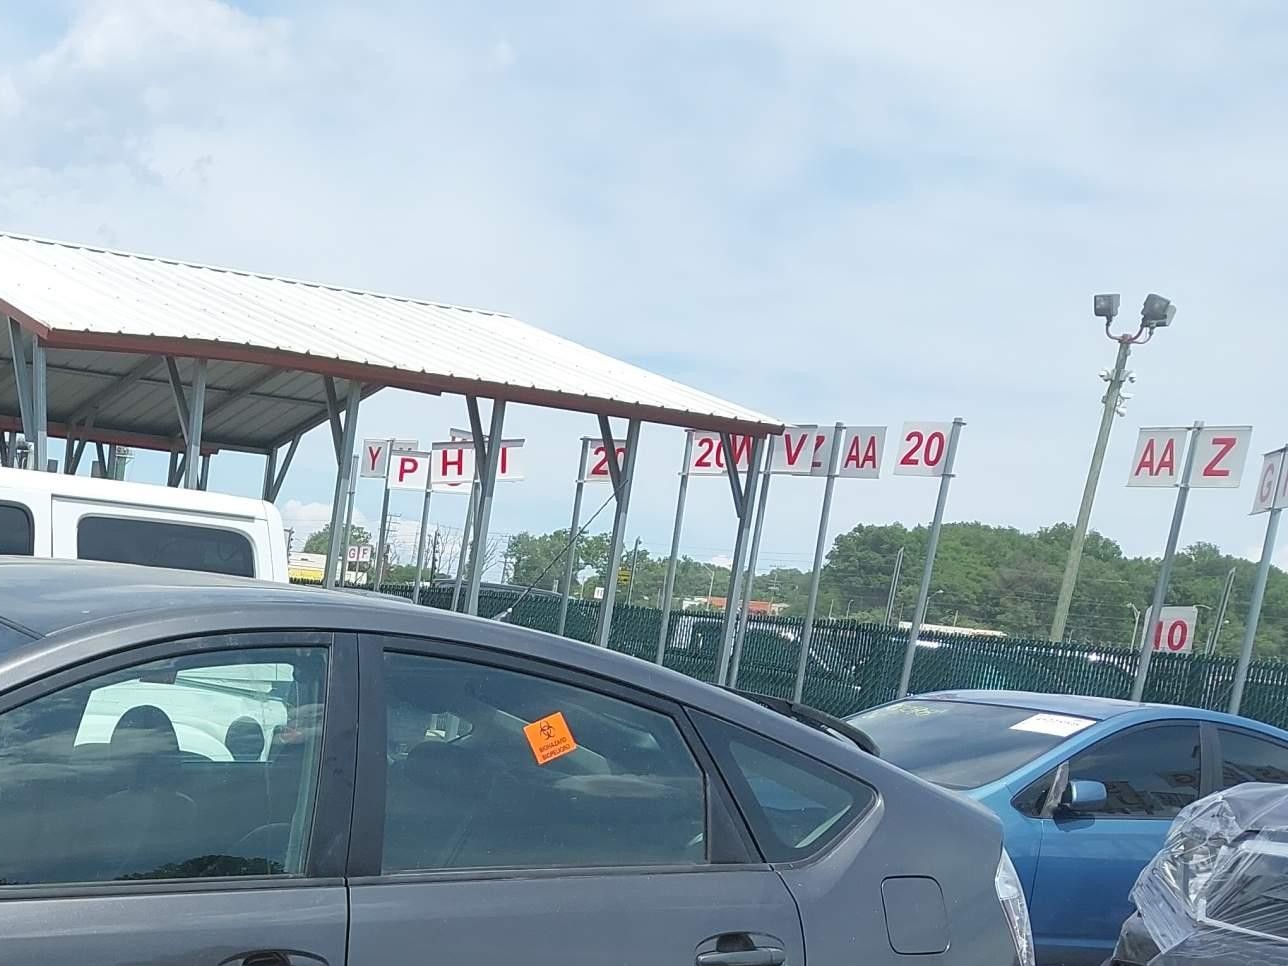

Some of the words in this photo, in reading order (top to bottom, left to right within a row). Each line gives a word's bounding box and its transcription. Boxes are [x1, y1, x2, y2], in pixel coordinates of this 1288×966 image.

[368, 446, 382, 471] Y
[441, 448, 464, 476] H
[784, 433, 808, 466] V
[843, 435, 877, 468] AA
[900, 431, 945, 466] 20
[1134, 438, 1174, 476] AA
[1203, 437, 1237, 476] Z
[399, 457, 419, 482] P
[1259, 463, 1275, 503] G
[1154, 620, 1188, 651] 10
